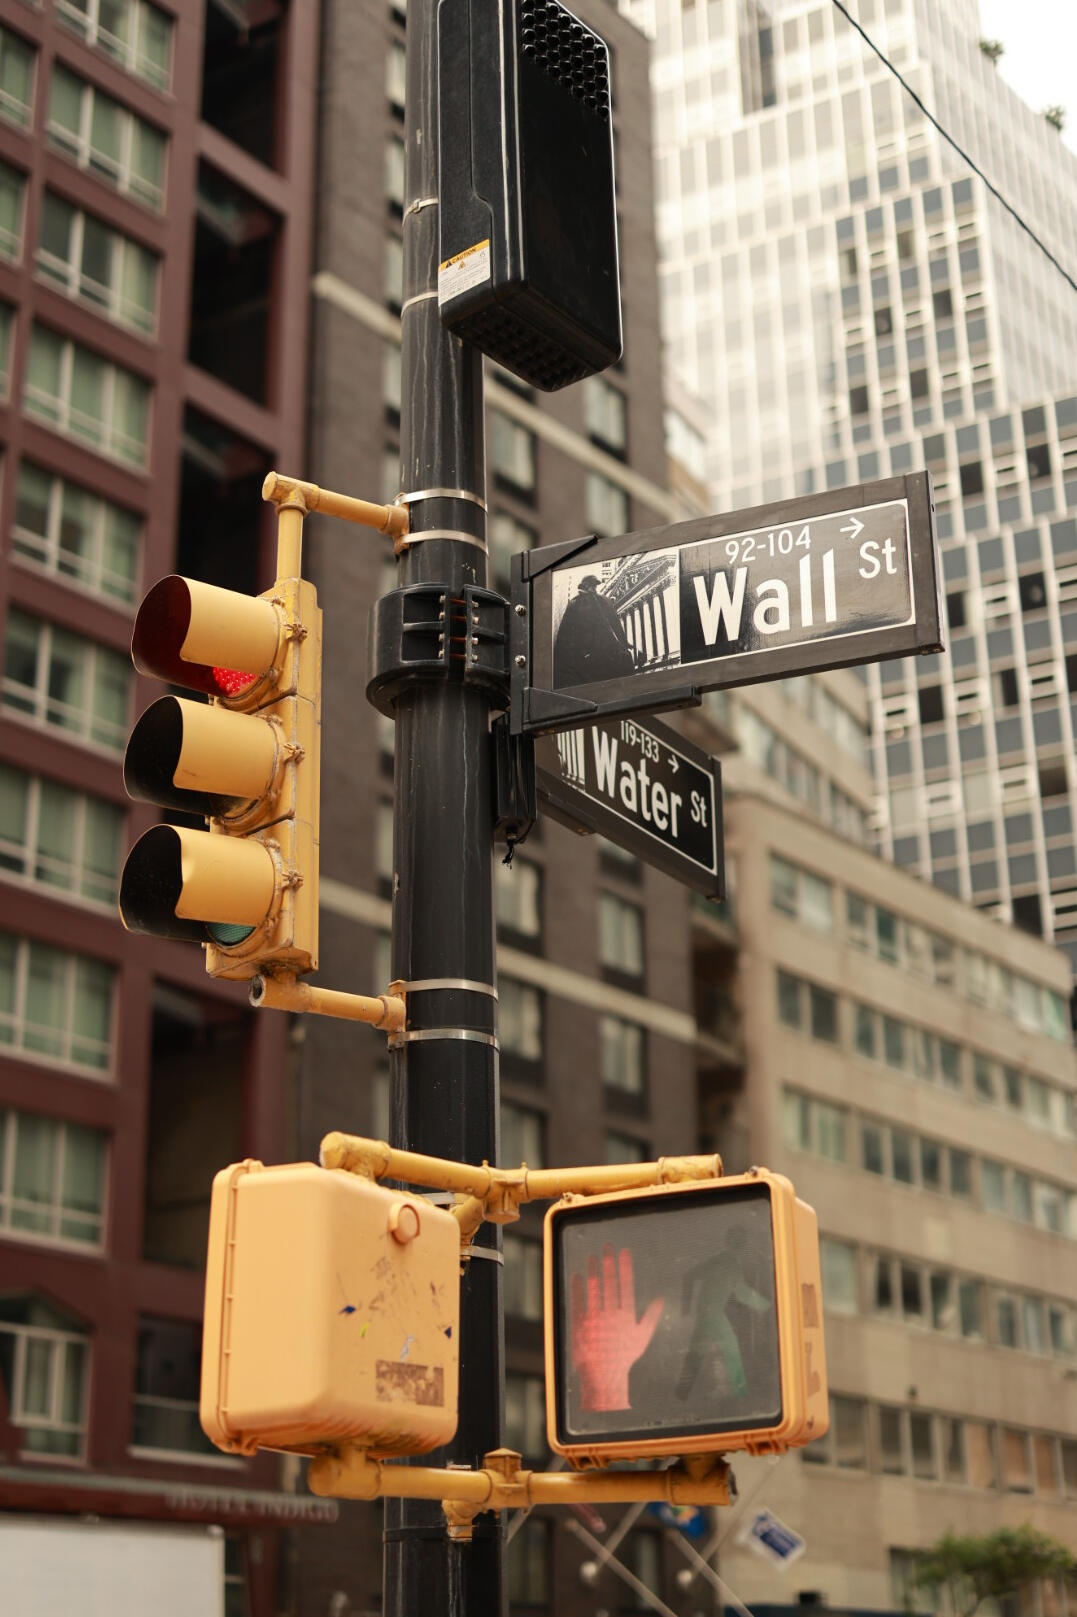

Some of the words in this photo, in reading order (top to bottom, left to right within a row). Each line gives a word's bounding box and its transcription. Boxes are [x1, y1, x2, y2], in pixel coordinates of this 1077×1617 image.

[452, 248, 476, 263] CAUTION
[725, 525, 812, 565] 92-104
[693, 549, 837, 646] Wall
[858, 537, 898, 579] St
[620, 720, 660, 763] 119-133
[591, 725, 682, 838] Water
[690, 790, 708, 828] St
